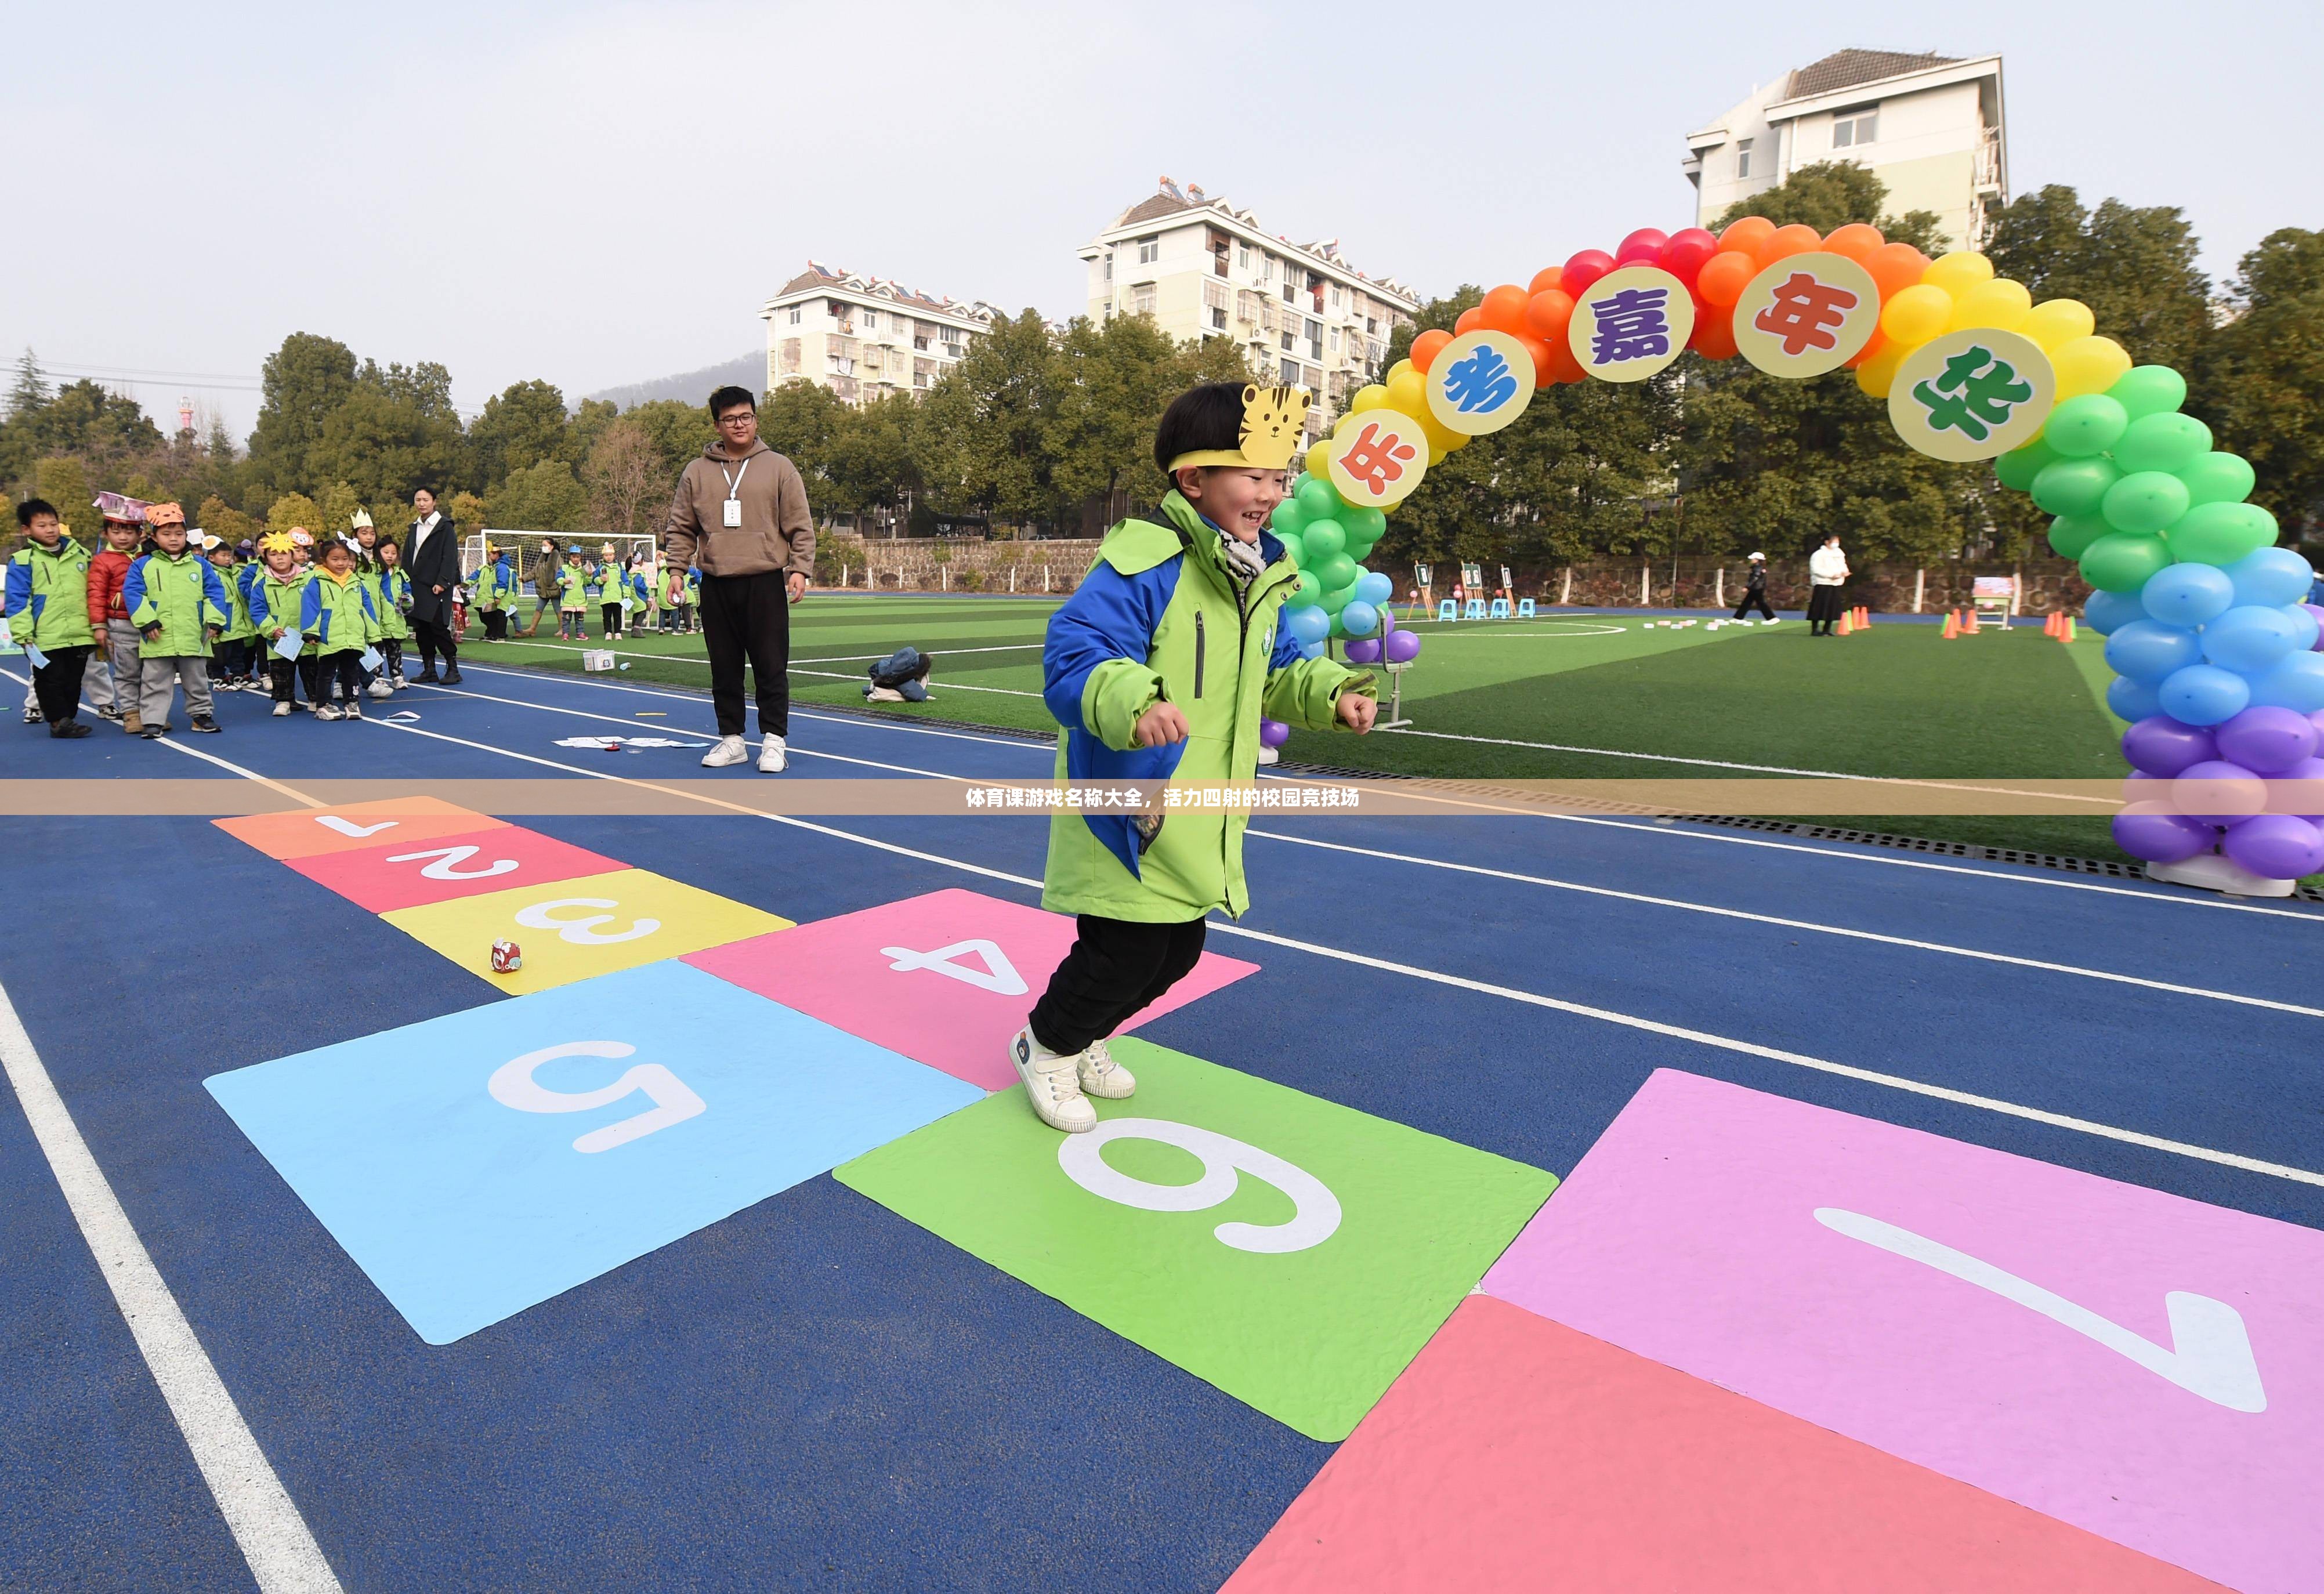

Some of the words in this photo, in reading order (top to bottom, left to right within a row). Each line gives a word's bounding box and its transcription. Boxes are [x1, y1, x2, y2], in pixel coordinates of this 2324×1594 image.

[314, 815, 399, 838] 1
[386, 845, 519, 880] 2
[515, 897, 661, 945] 3
[879, 939, 1029, 995] 4
[488, 1041, 707, 1153] 5
[1058, 1118, 1342, 1254] 6
